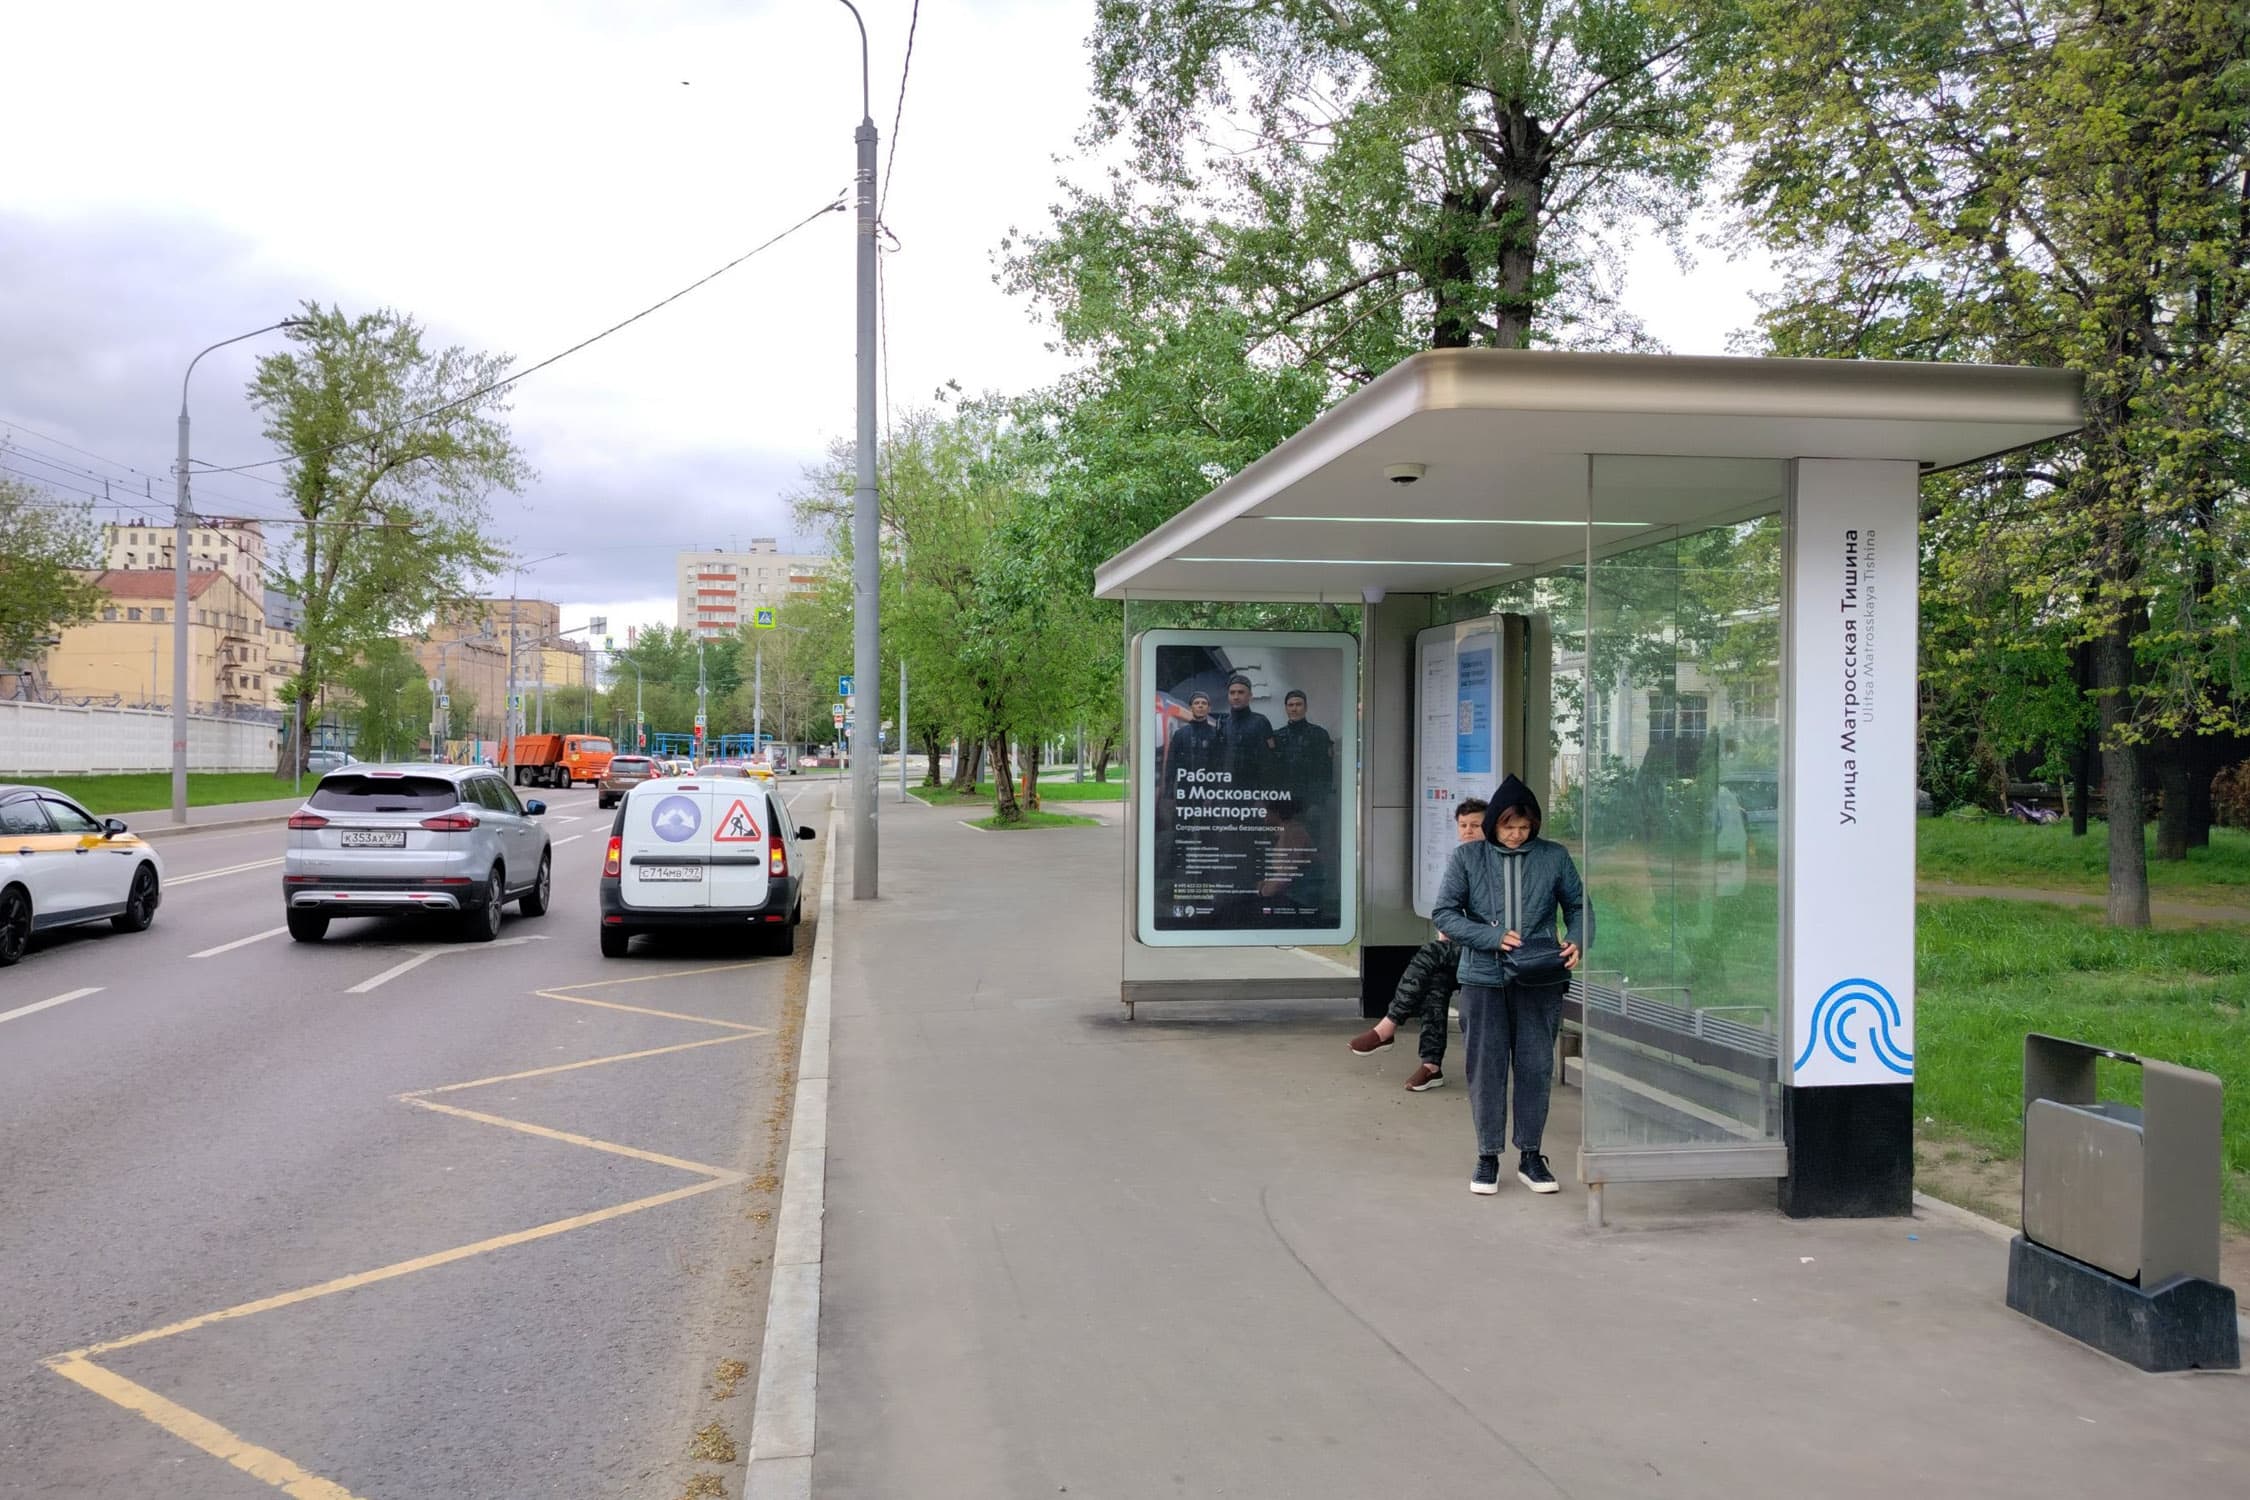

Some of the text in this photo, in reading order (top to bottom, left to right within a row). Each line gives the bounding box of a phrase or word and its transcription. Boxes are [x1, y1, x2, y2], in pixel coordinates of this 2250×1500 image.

[1862, 529, 1878, 723] Ulitsa Matrosskaya Tishina
[1840, 529, 1860, 825] Улица Матросская Тишина
[1176, 768, 1232, 783] Работа
[1176, 786, 1292, 801] в Московском
[1175, 806, 1268, 821] транспорте
[1212, 824, 1238, 832] службы
[1239, 824, 1285, 832] безопасности
